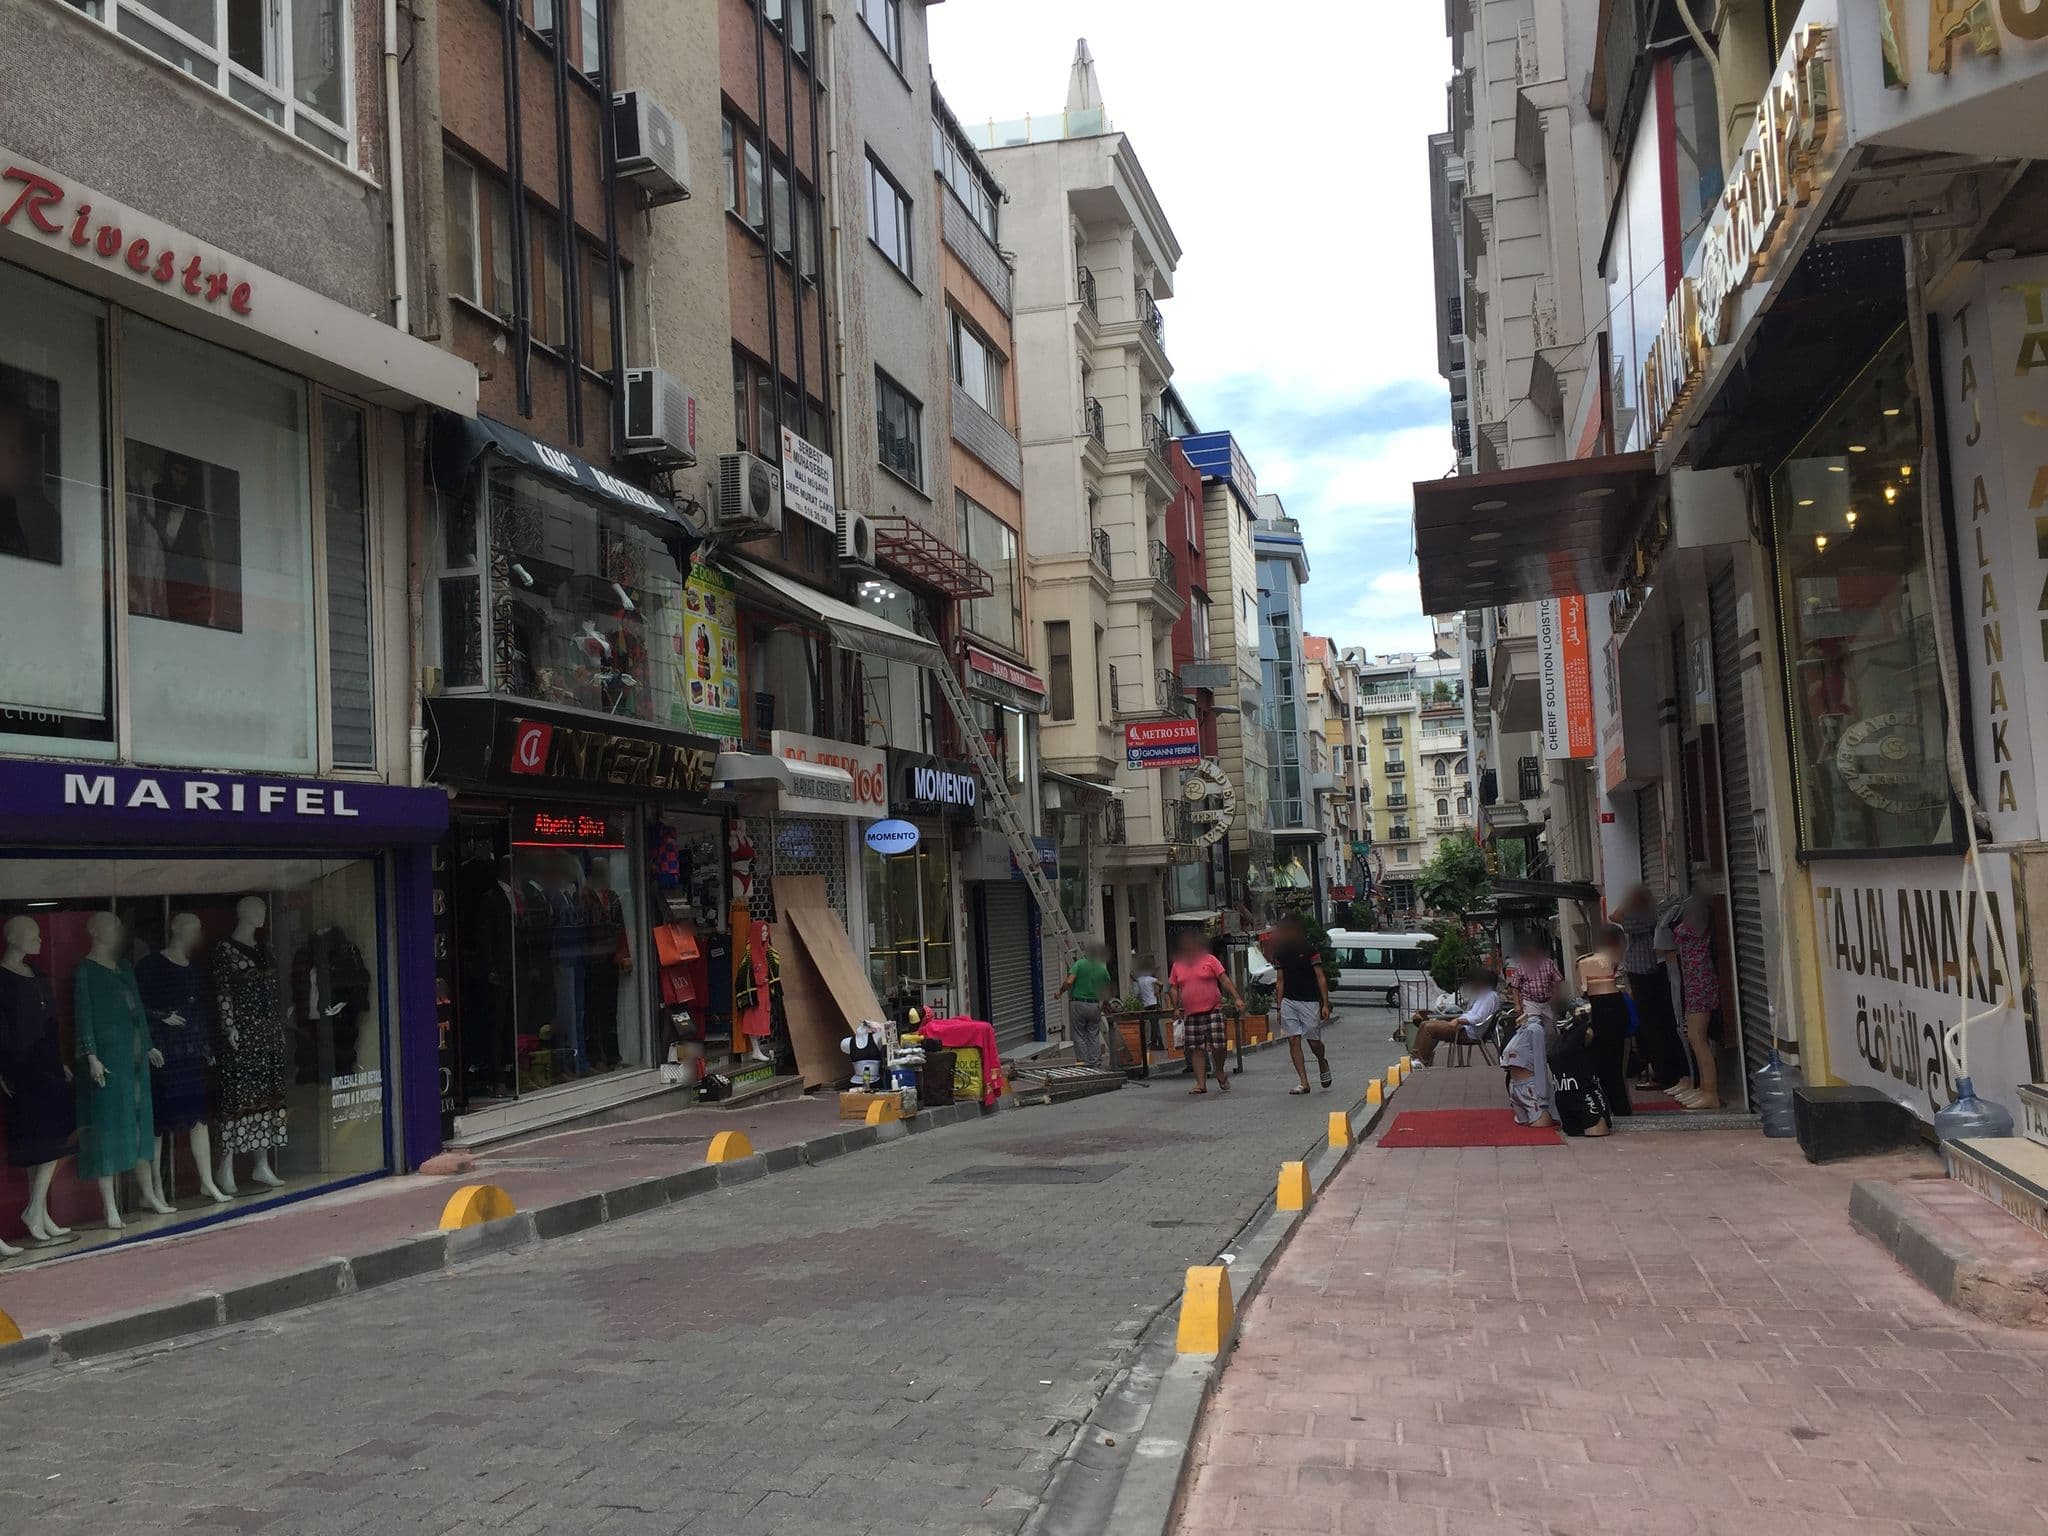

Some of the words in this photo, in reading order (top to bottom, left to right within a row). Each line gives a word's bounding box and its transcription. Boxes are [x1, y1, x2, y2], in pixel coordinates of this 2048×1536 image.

[0, 166, 252, 315] Rivestre
[532, 440, 578, 478] KING
[1543, 652, 1557, 708] SOLUTION
[1142, 728, 1173, 740] METRO
[1173, 726, 1197, 738] STAR
[1547, 711, 1559, 751] CHERIF
[64, 773, 359, 817] MARIFEL
[914, 766, 976, 807] MOMENTO
[866, 831, 916, 842] MOMENTO
